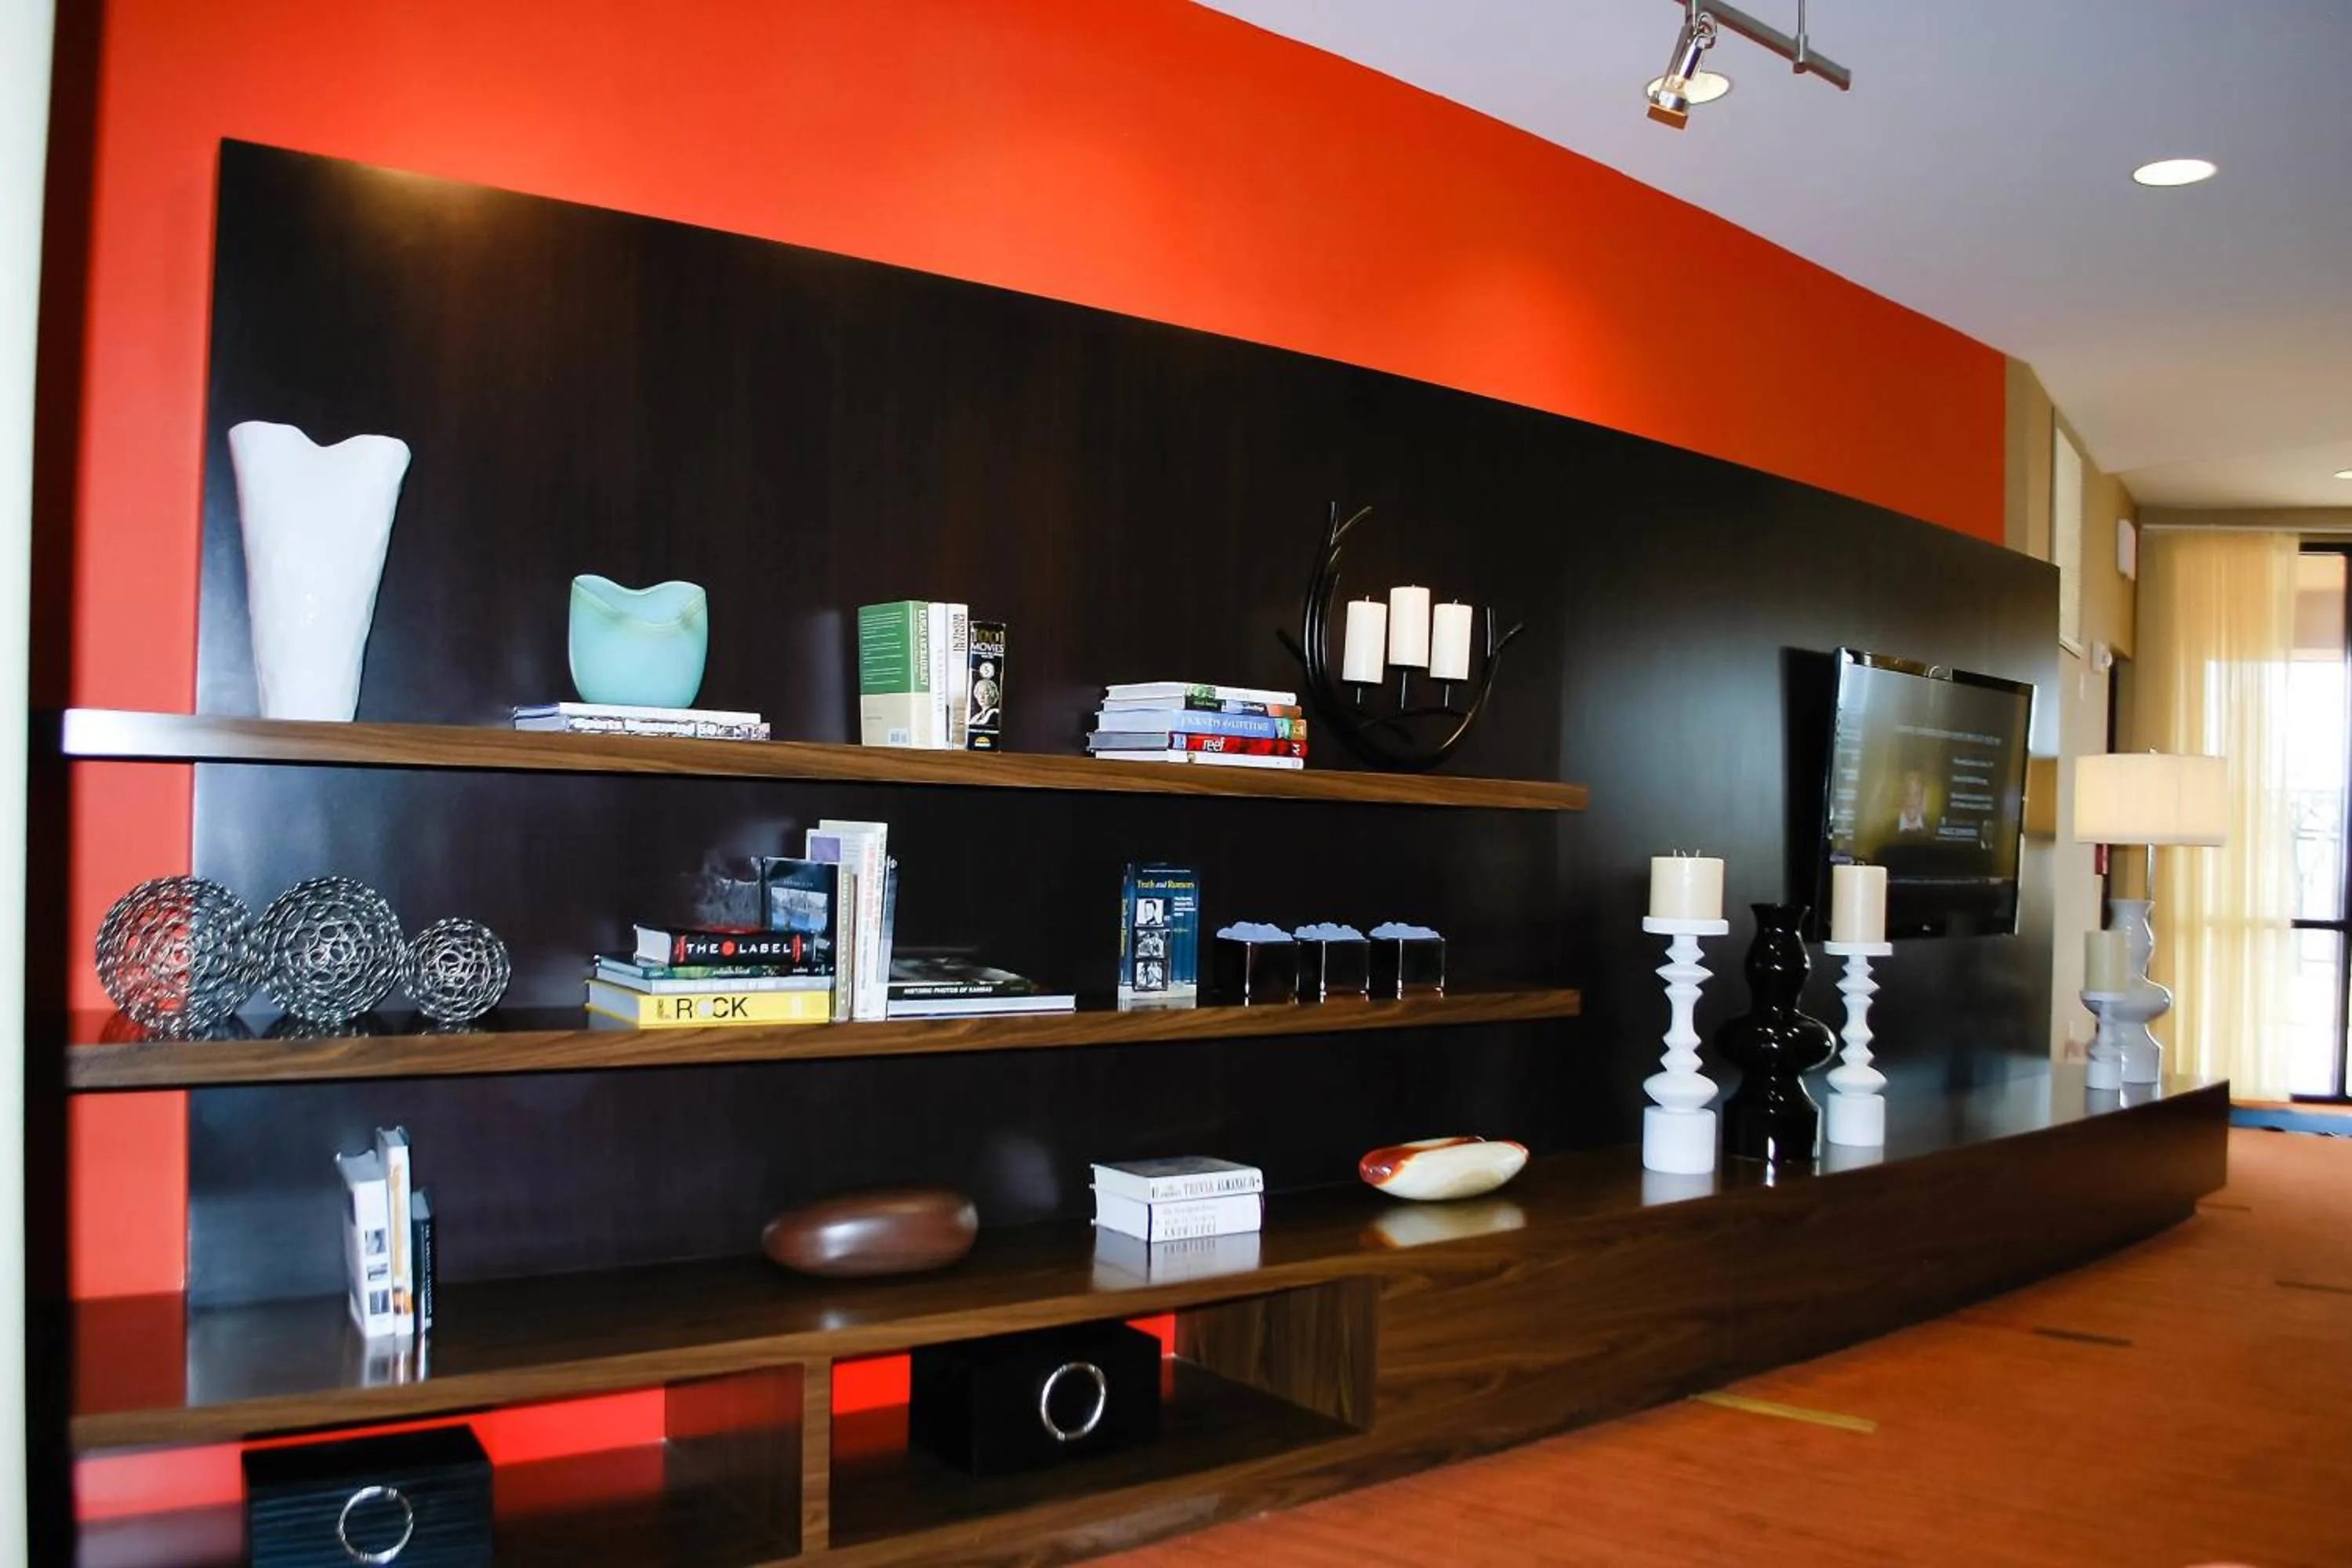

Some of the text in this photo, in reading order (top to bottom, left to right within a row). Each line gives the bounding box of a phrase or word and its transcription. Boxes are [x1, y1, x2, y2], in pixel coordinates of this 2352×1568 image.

[971, 643, 1004, 653] MOVIES
[1203, 736, 1225, 752] reef
[686, 942, 719, 955] THE
[739, 942, 792, 955] LABEL
[1184, 1181, 1214, 1195] TRIVIA
